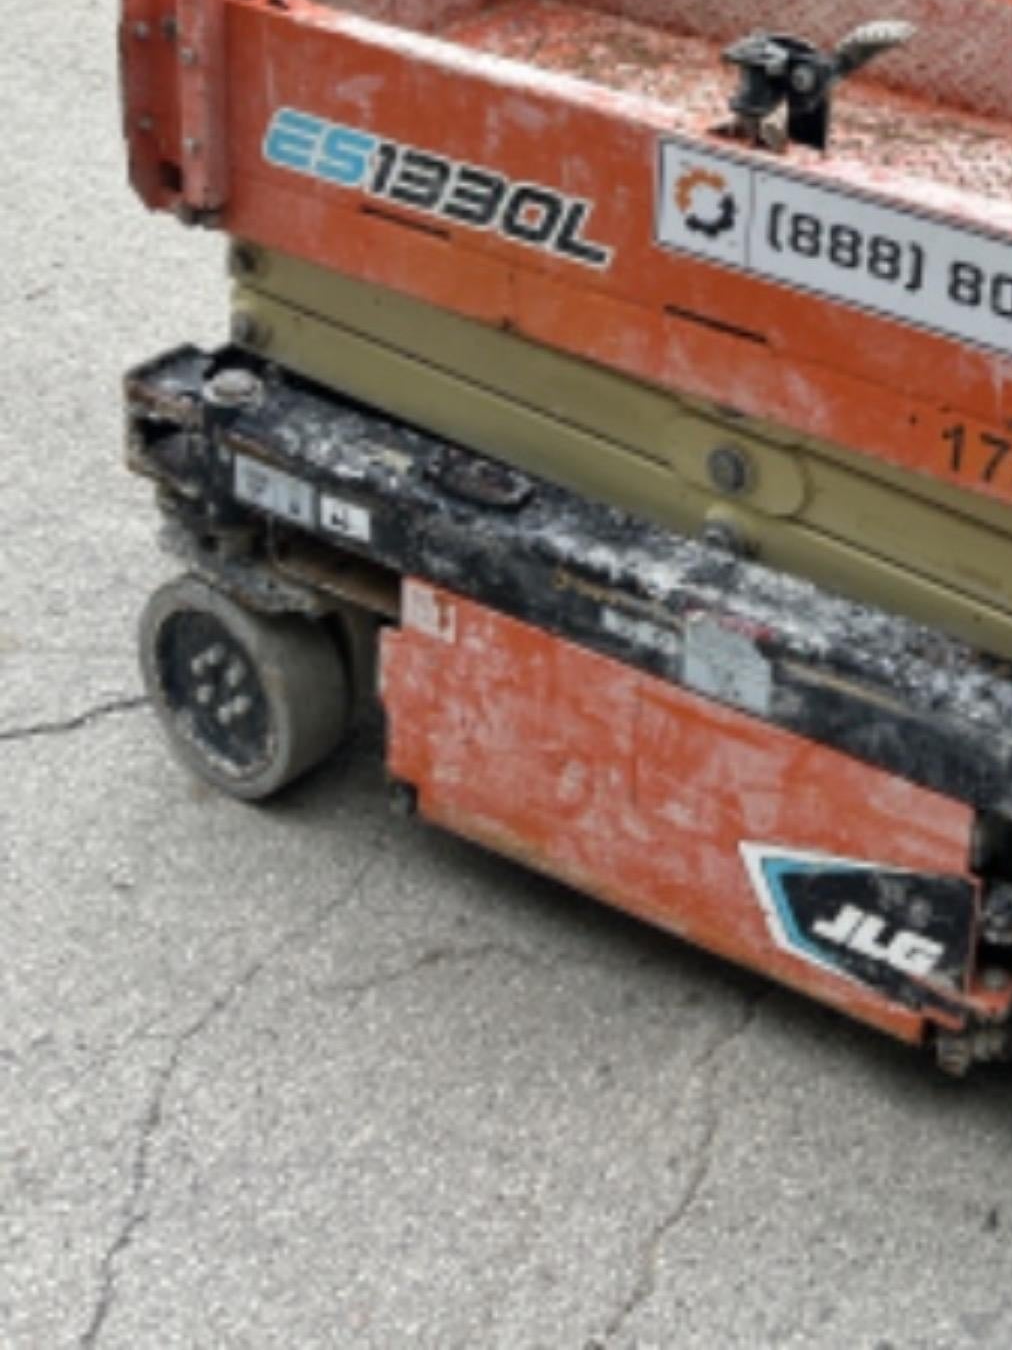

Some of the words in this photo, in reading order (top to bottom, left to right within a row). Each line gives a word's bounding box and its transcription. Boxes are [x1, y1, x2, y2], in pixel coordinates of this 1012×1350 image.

[264, 109, 613, 270] ES1330L
[767, 201, 926, 292] (888)
[812, 905, 945, 977] JLG
